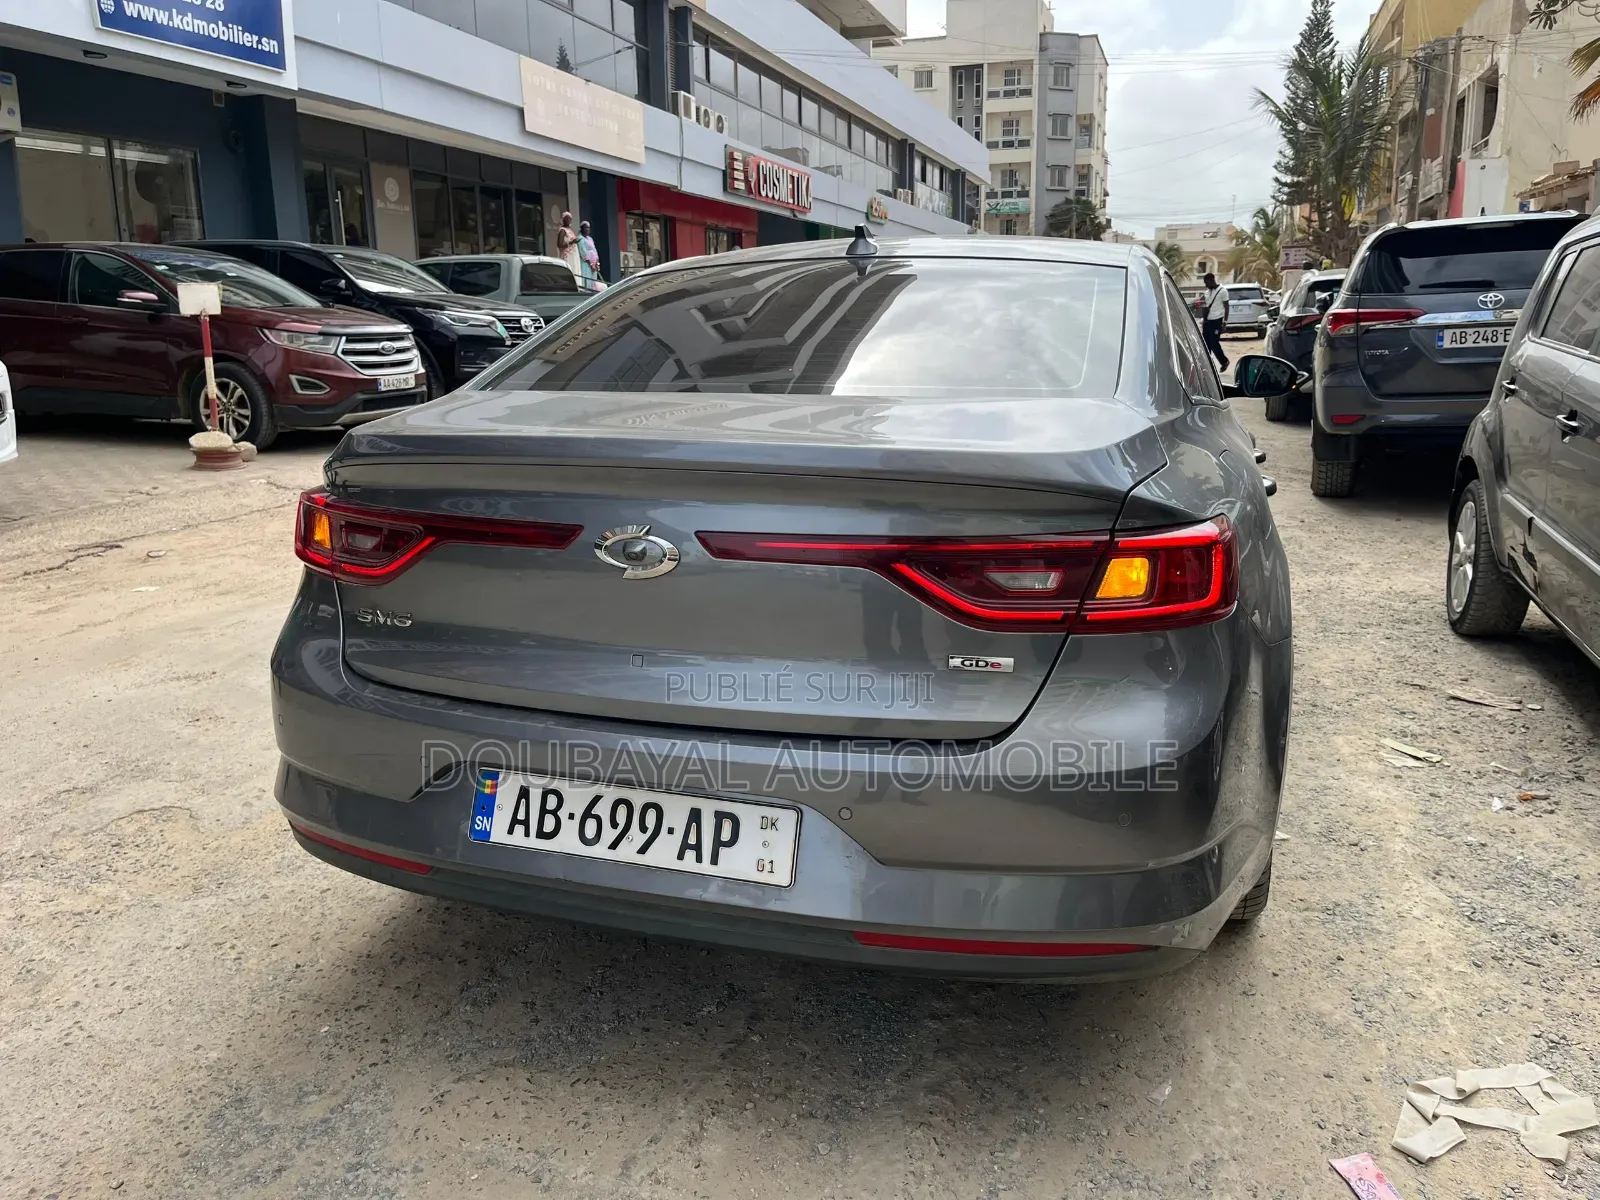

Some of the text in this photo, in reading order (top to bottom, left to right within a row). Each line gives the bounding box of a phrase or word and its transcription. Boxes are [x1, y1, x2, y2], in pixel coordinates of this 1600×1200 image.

[123, 1, 279, 54] www.kdmobilier.sn
[759, 160, 812, 210] COSMETIKA
[961, 658, 1002, 669] GDe
[474, 815, 491, 832] SN
[760, 816, 779, 832] DK
[756, 858, 775, 874] 01
